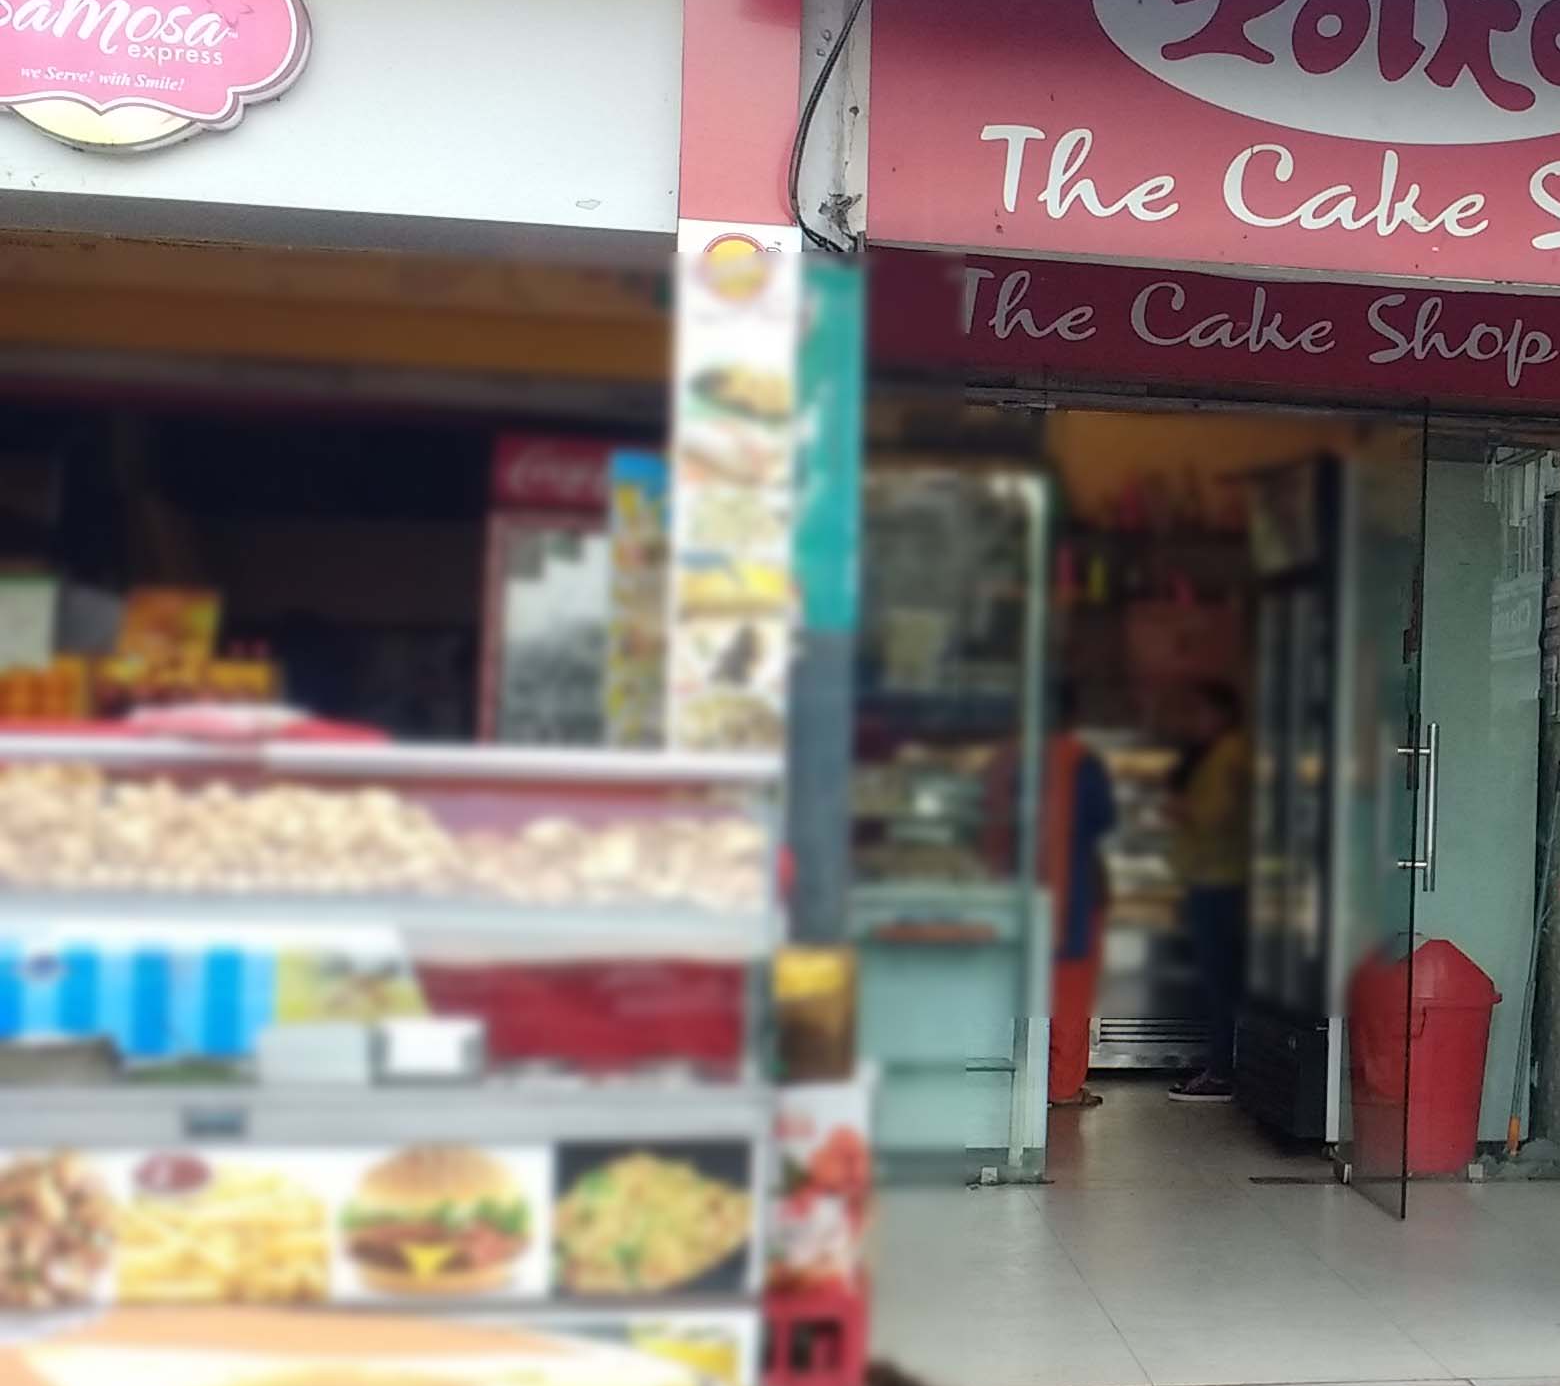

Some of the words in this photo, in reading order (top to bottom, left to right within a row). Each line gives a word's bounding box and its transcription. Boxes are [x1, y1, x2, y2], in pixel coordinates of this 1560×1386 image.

[100, 70, 131, 87] with
[135, 73, 186, 92] Smile!
[128, 44, 224, 67] express
[980, 124, 1180, 222] The
[1223, 143, 1490, 240] Cake
[956, 266, 1097, 344] The
[1130, 281, 1336, 355] Cake
[1368, 294, 1560, 388] Shop
